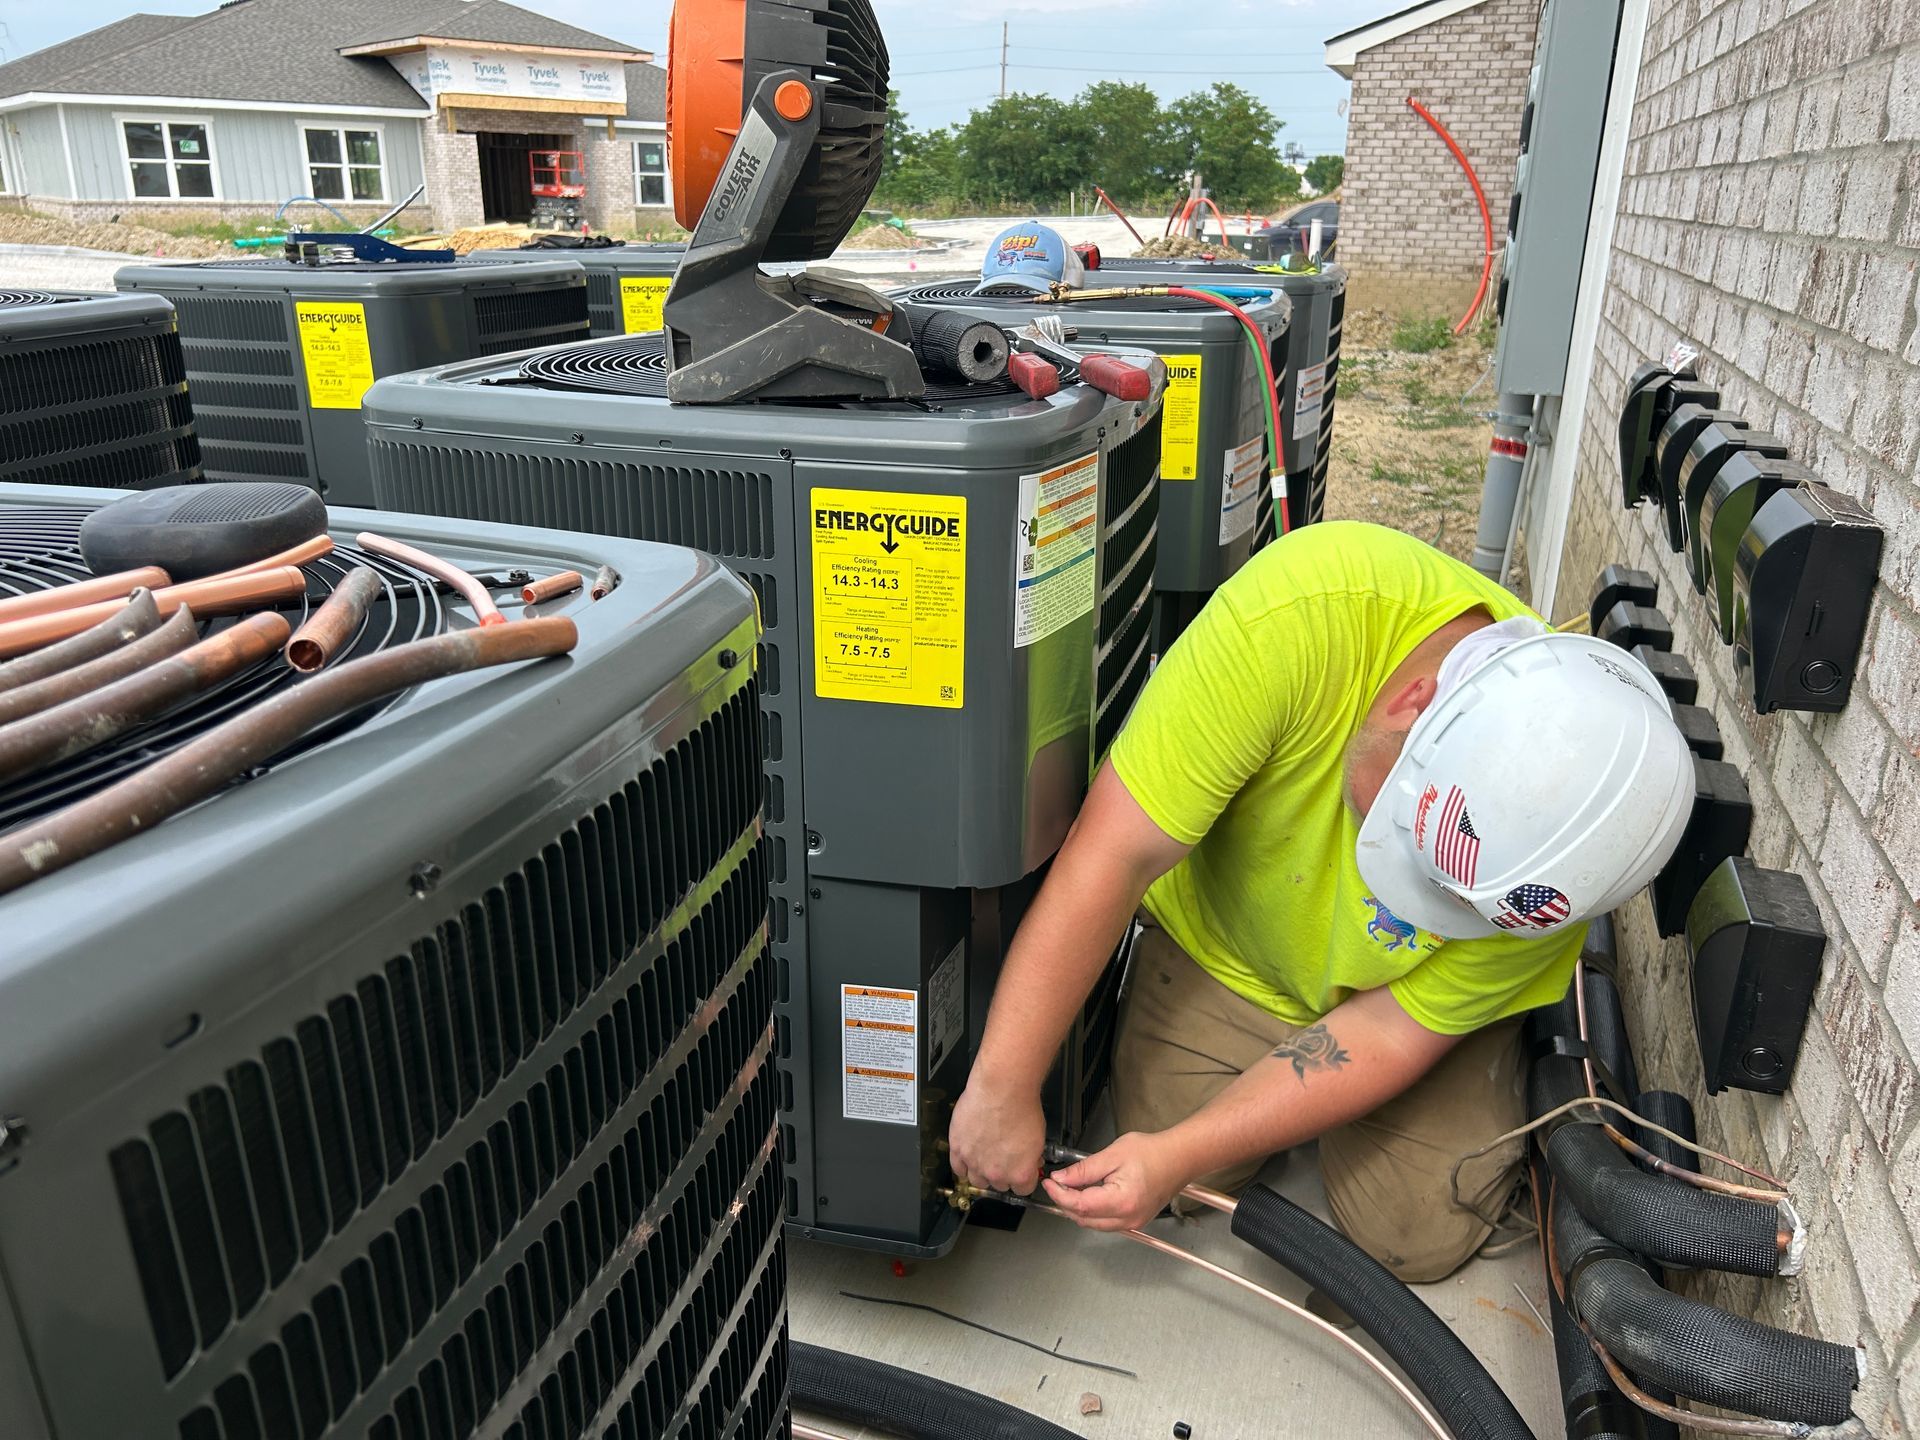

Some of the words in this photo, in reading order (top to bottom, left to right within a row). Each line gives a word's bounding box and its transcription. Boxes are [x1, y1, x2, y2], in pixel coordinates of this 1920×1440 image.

[472, 62, 505, 75] Tyvek
[526, 66, 559, 80] Tyvek
[579, 70, 610, 83] Tyvek
[740, 156, 760, 193] AIR
[714, 146, 750, 222] COVERT
[1001, 235, 1039, 251] Zip!
[300, 314, 362, 324] ENERGYGUIDE
[816, 509, 960, 537] ENERGYGUIDE
[854, 557, 877, 566] Cooling
[832, 564, 860, 572] Efficiency
[862, 566, 882, 574] Rating
[856, 626, 878, 634] Heating
[834, 632, 862, 640] Efficiency
[864, 634, 883, 642] Rating
[870, 990, 899, 998] WARNING
[861, 1070, 908, 1078] AVERTISSEMENT
